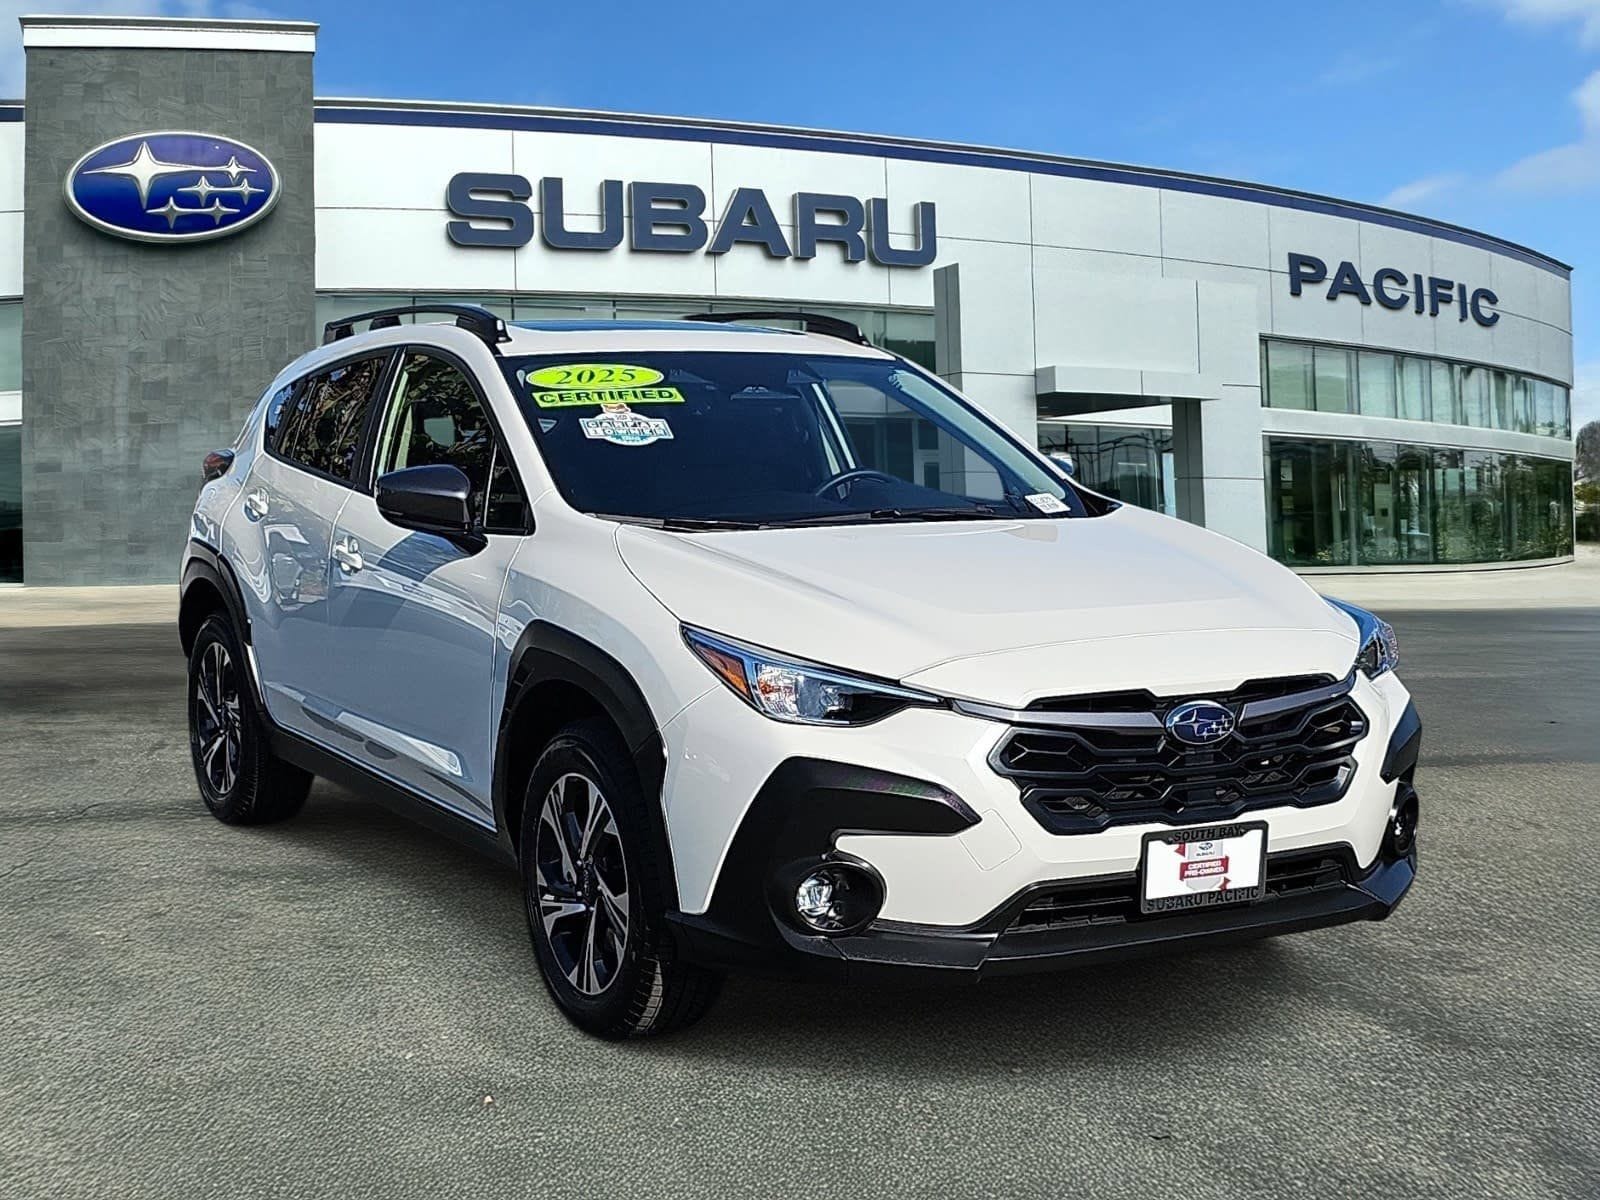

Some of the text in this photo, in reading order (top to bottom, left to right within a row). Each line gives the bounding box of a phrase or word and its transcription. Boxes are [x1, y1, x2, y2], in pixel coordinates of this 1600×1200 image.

[447, 172, 937, 268] SUBARU
[1287, 252, 1500, 327] PACIFIC
[556, 369, 638, 385] 2025
[539, 389, 675, 404] CERTIFIED
[1173, 825, 1241, 842] SOUTH BAY
[1146, 888, 1260, 911] SUBARU PACIFIC
